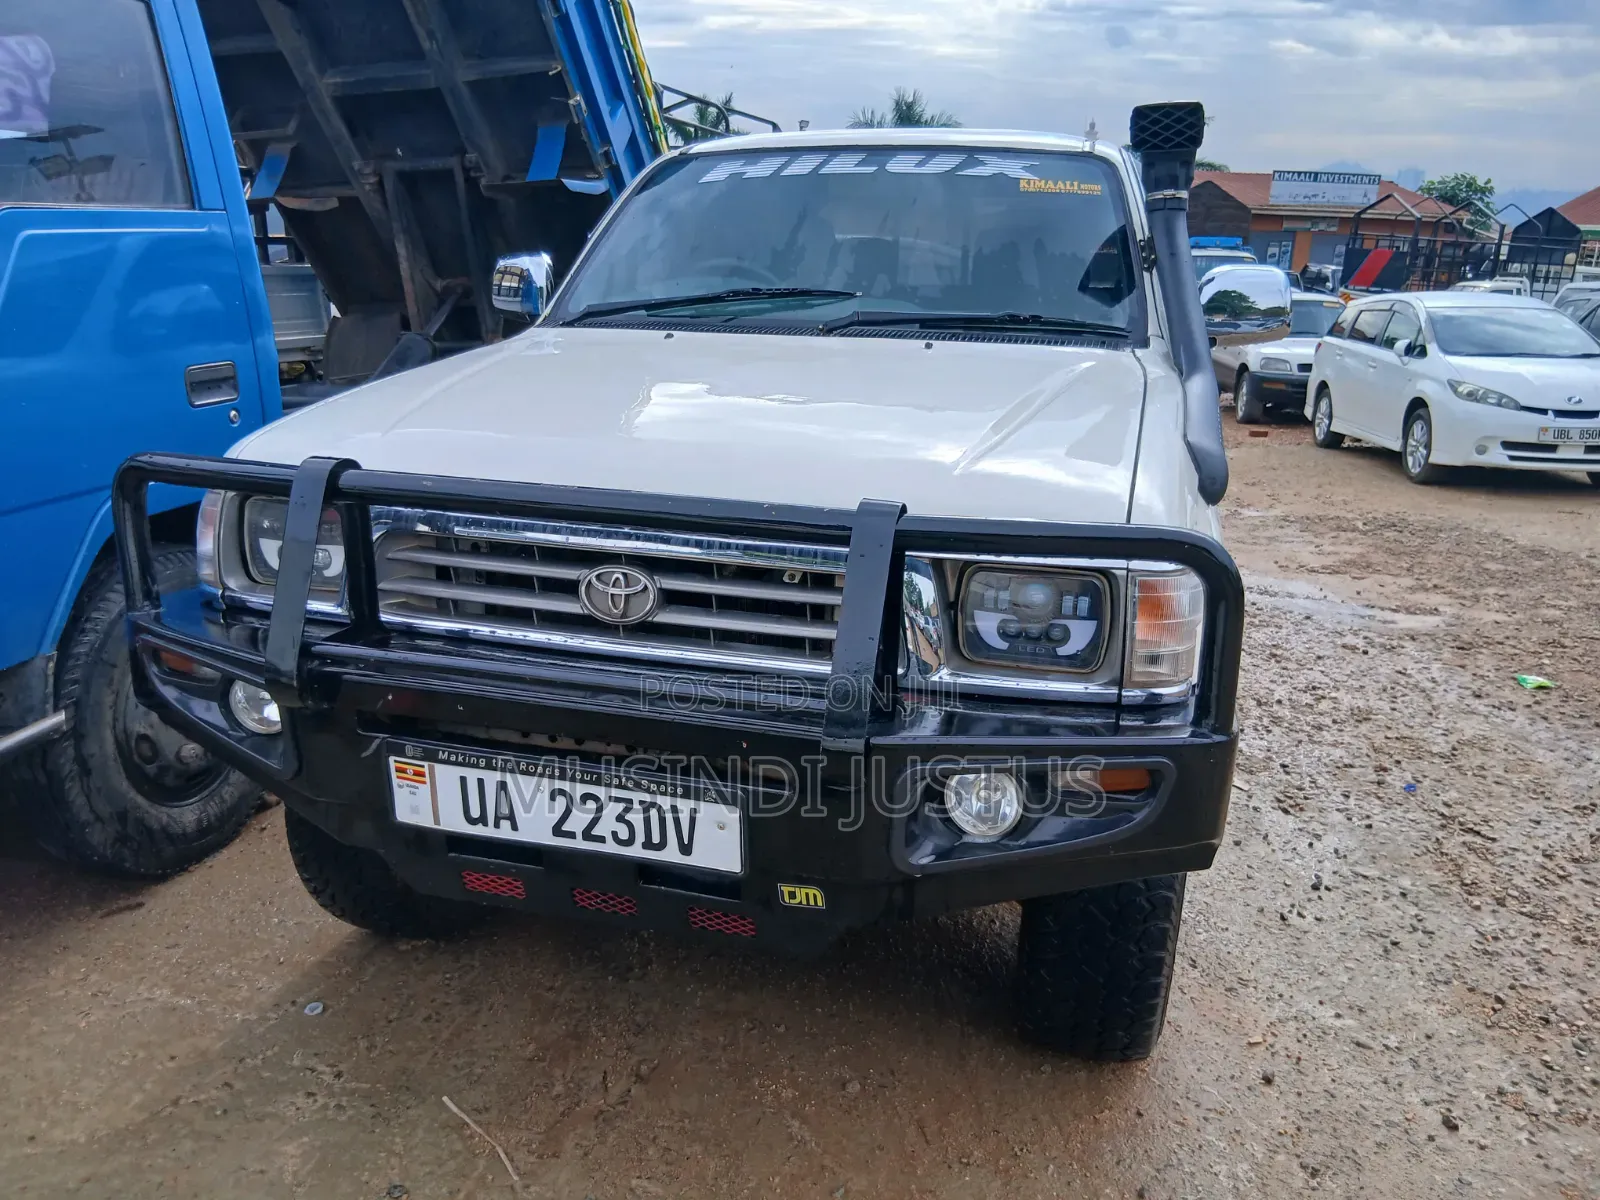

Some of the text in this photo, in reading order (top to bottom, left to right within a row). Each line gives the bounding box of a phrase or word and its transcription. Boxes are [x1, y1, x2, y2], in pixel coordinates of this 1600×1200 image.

[698, 153, 1040, 183] HILUX
[1273, 171, 1380, 185] KIMAALI INVESTMENTS
[1019, 179, 1079, 190] KIMAALI
[1552, 429, 1573, 440] UBL
[438, 751, 684, 796] Making the Roads Your Safe Space
[459, 776, 698, 856] UA 223DV
